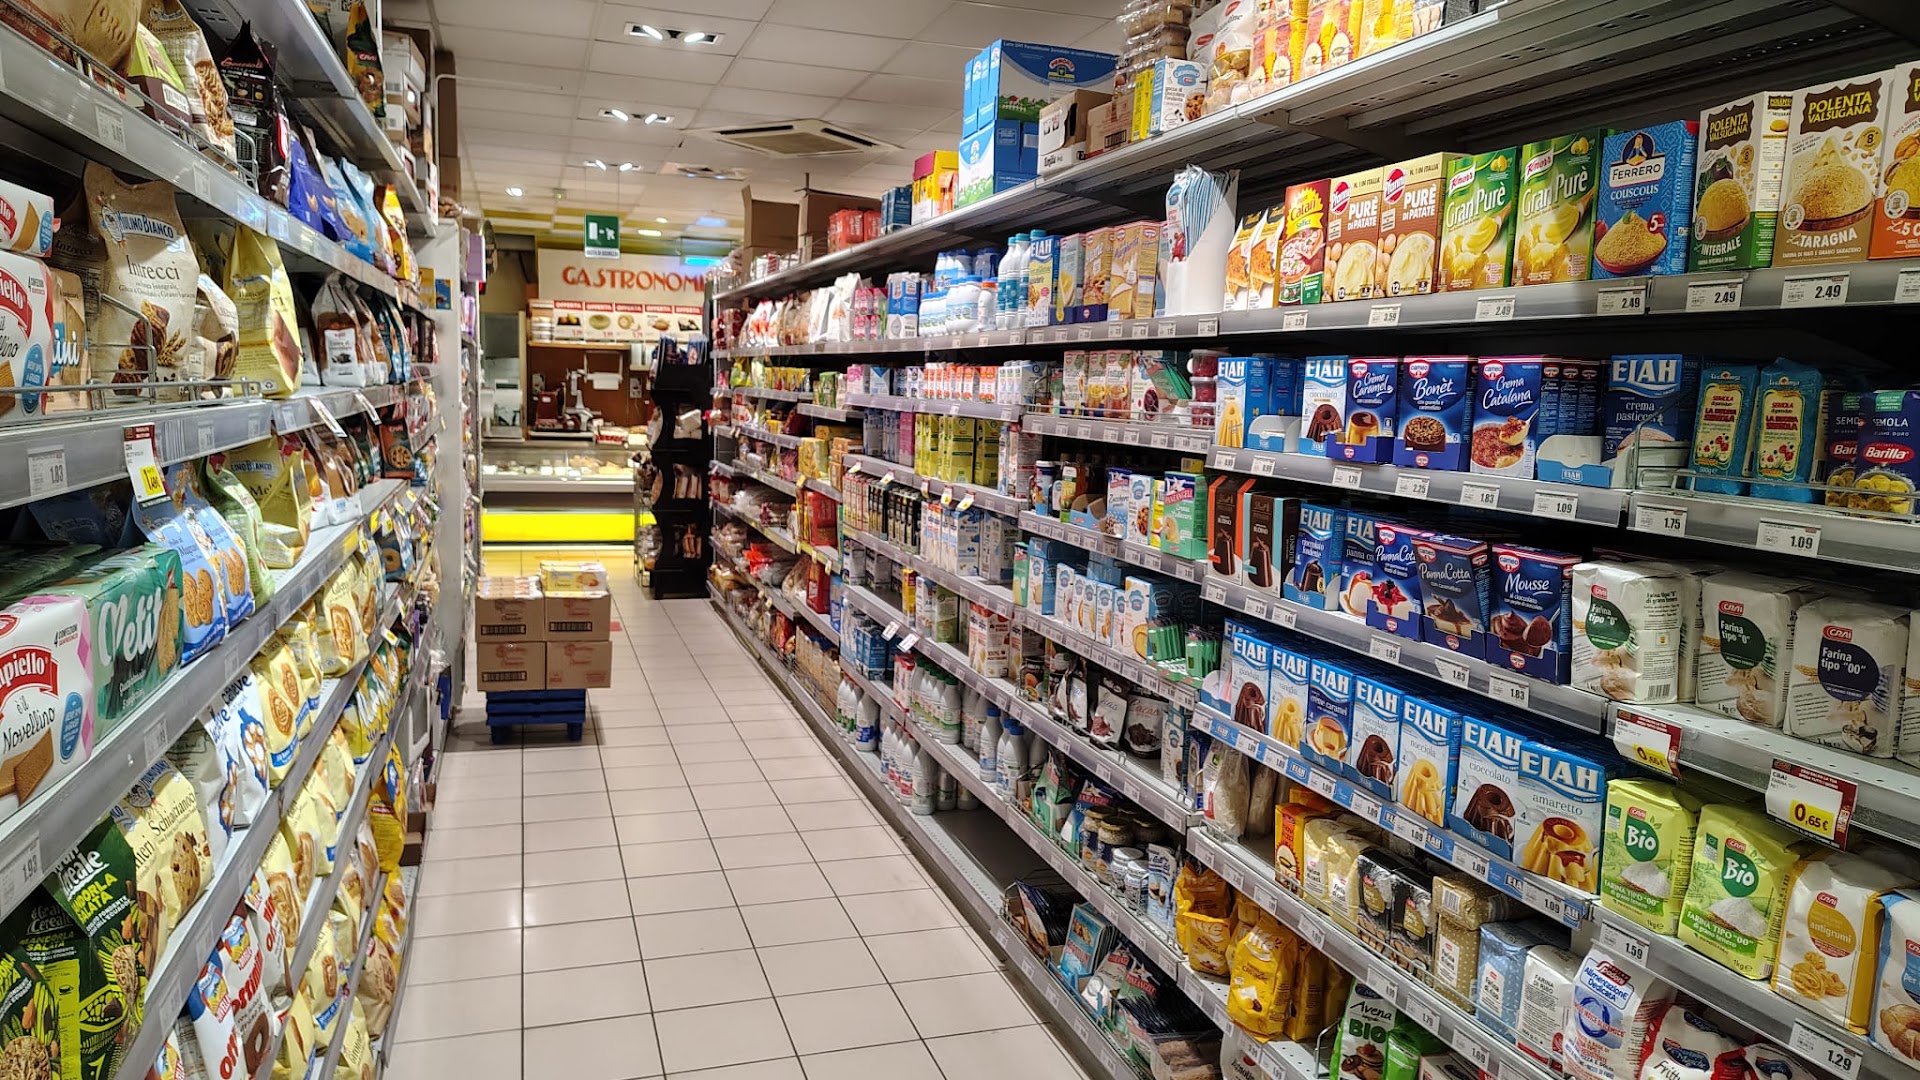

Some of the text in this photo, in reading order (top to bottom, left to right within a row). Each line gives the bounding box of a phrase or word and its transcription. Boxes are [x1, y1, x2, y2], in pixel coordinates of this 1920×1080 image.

[1809, 91, 1872, 115] POLENTA
[1807, 105, 1871, 123] VALSUGANA
[1709, 112, 1748, 134] POLENTA
[1709, 125, 1748, 142] VALSUGANA
[1867, 134, 1873, 143] 8
[1526, 156, 1552, 176] Knorr
[1612, 163, 1661, 180] FERRERO
[1385, 174, 1405, 196] Pfanni
[1451, 170, 1473, 189] Knorr
[1553, 167, 1588, 204] Purè
[1404, 183, 1437, 209] PURÈ
[1474, 182, 1506, 215] Purè
[1349, 196, 1378, 220] PURÈ
[1409, 206, 1435, 219] PATATE
[143, 215, 174, 239] BIANCO
[1353, 216, 1376, 229] PATATE
[1650, 214, 1658, 232] 5
[1902, 222, 1908, 235] 5
[1800, 227, 1857, 248] TARAGNA
[126, 254, 180, 280] Intrecci
[1392, 283, 1400, 292] 12
[1814, 285, 1841, 299] 2.49
[1622, 297, 1640, 309] 2.49
[1714, 291, 1736, 304] 2.49
[1384, 312, 1397, 322] 3.59
[1495, 306, 1511, 316] 2.49
[1218, 361, 1244, 377] ELAH
[1306, 360, 1343, 377] ELAH
[1612, 360, 1677, 383] ELAH
[1364, 373, 1386, 385] Crème
[1496, 376, 1524, 391] Crema
[1309, 390, 1338, 399] cioccolato
[1353, 379, 1388, 398] Caramel
[1413, 377, 1453, 401] Bonèt
[1483, 388, 1531, 409] Catalana
[1625, 402, 1655, 411] crema
[1866, 446, 1907, 460] Barilla
[50, 465, 64, 484] 1.83
[1562, 469, 1581, 481] ELAH
[1413, 484, 1426, 494] 2.25
[1481, 493, 1494, 503] 1.83
[1556, 503, 1572, 514] 1.09
[1301, 508, 1331, 530] ELAH
[1664, 517, 1681, 529] 1.75
[1379, 531, 1395, 539] cameo
[1790, 536, 1813, 549] 1.09
[1347, 548, 1365, 560] panna
[1500, 557, 1519, 565] cameo
[1505, 573, 1549, 592] Mousse
[1592, 604, 1612, 616] Farina
[1589, 613, 1605, 625] tipo
[1721, 620, 1743, 634] Farina
[54, 632, 58, 647] 4
[1721, 631, 1737, 644] tipo
[1234, 636, 1267, 662] ELAH
[1386, 650, 1397, 659] 1.83
[1822, 647, 1852, 662] Farina
[1273, 650, 1307, 677] ELAH
[1821, 658, 1840, 671] tipo
[1311, 662, 1349, 695] ELAH
[1453, 670, 1466, 681] 1.83
[1356, 679, 1398, 714] ELAH
[1511, 689, 1525, 700] 1.83
[1326, 702, 1348, 716] caramel
[1404, 700, 1448, 736] ELAH
[3, 707, 55, 754] Novellino
[1410, 738, 1437, 758] nocciola
[1464, 721, 1522, 760] ELAH
[1292, 764, 1306, 778] ELAH
[1469, 761, 1511, 785] cioccolato
[1521, 749, 1599, 793] ELAH
[1367, 806, 1378, 818] 1.09
[1532, 793, 1583, 816] amaretto
[1521, 811, 1526, 820] 4
[1411, 829, 1424, 842] 1.09
[22, 854, 38, 882] 1.93
[1472, 862, 1486, 875] 1.09
[1604, 880, 1643, 900] FARINA TIPO
[1545, 899, 1560, 914] 1.09
[1687, 911, 1732, 939] FARINA TIPO
[1810, 922, 1852, 943] antigrumi
[1699, 926, 1715, 937] grano
[1716, 934, 1737, 948] tenero
[1626, 943, 1643, 960] 1.59
[1535, 974, 1554, 989] FARINA
[1905, 974, 1916, 985] per
[1350, 1001, 1392, 1020] Avena
[1349, 1018, 1386, 1043] BIO
[1827, 1050, 1852, 1071] 1.29
